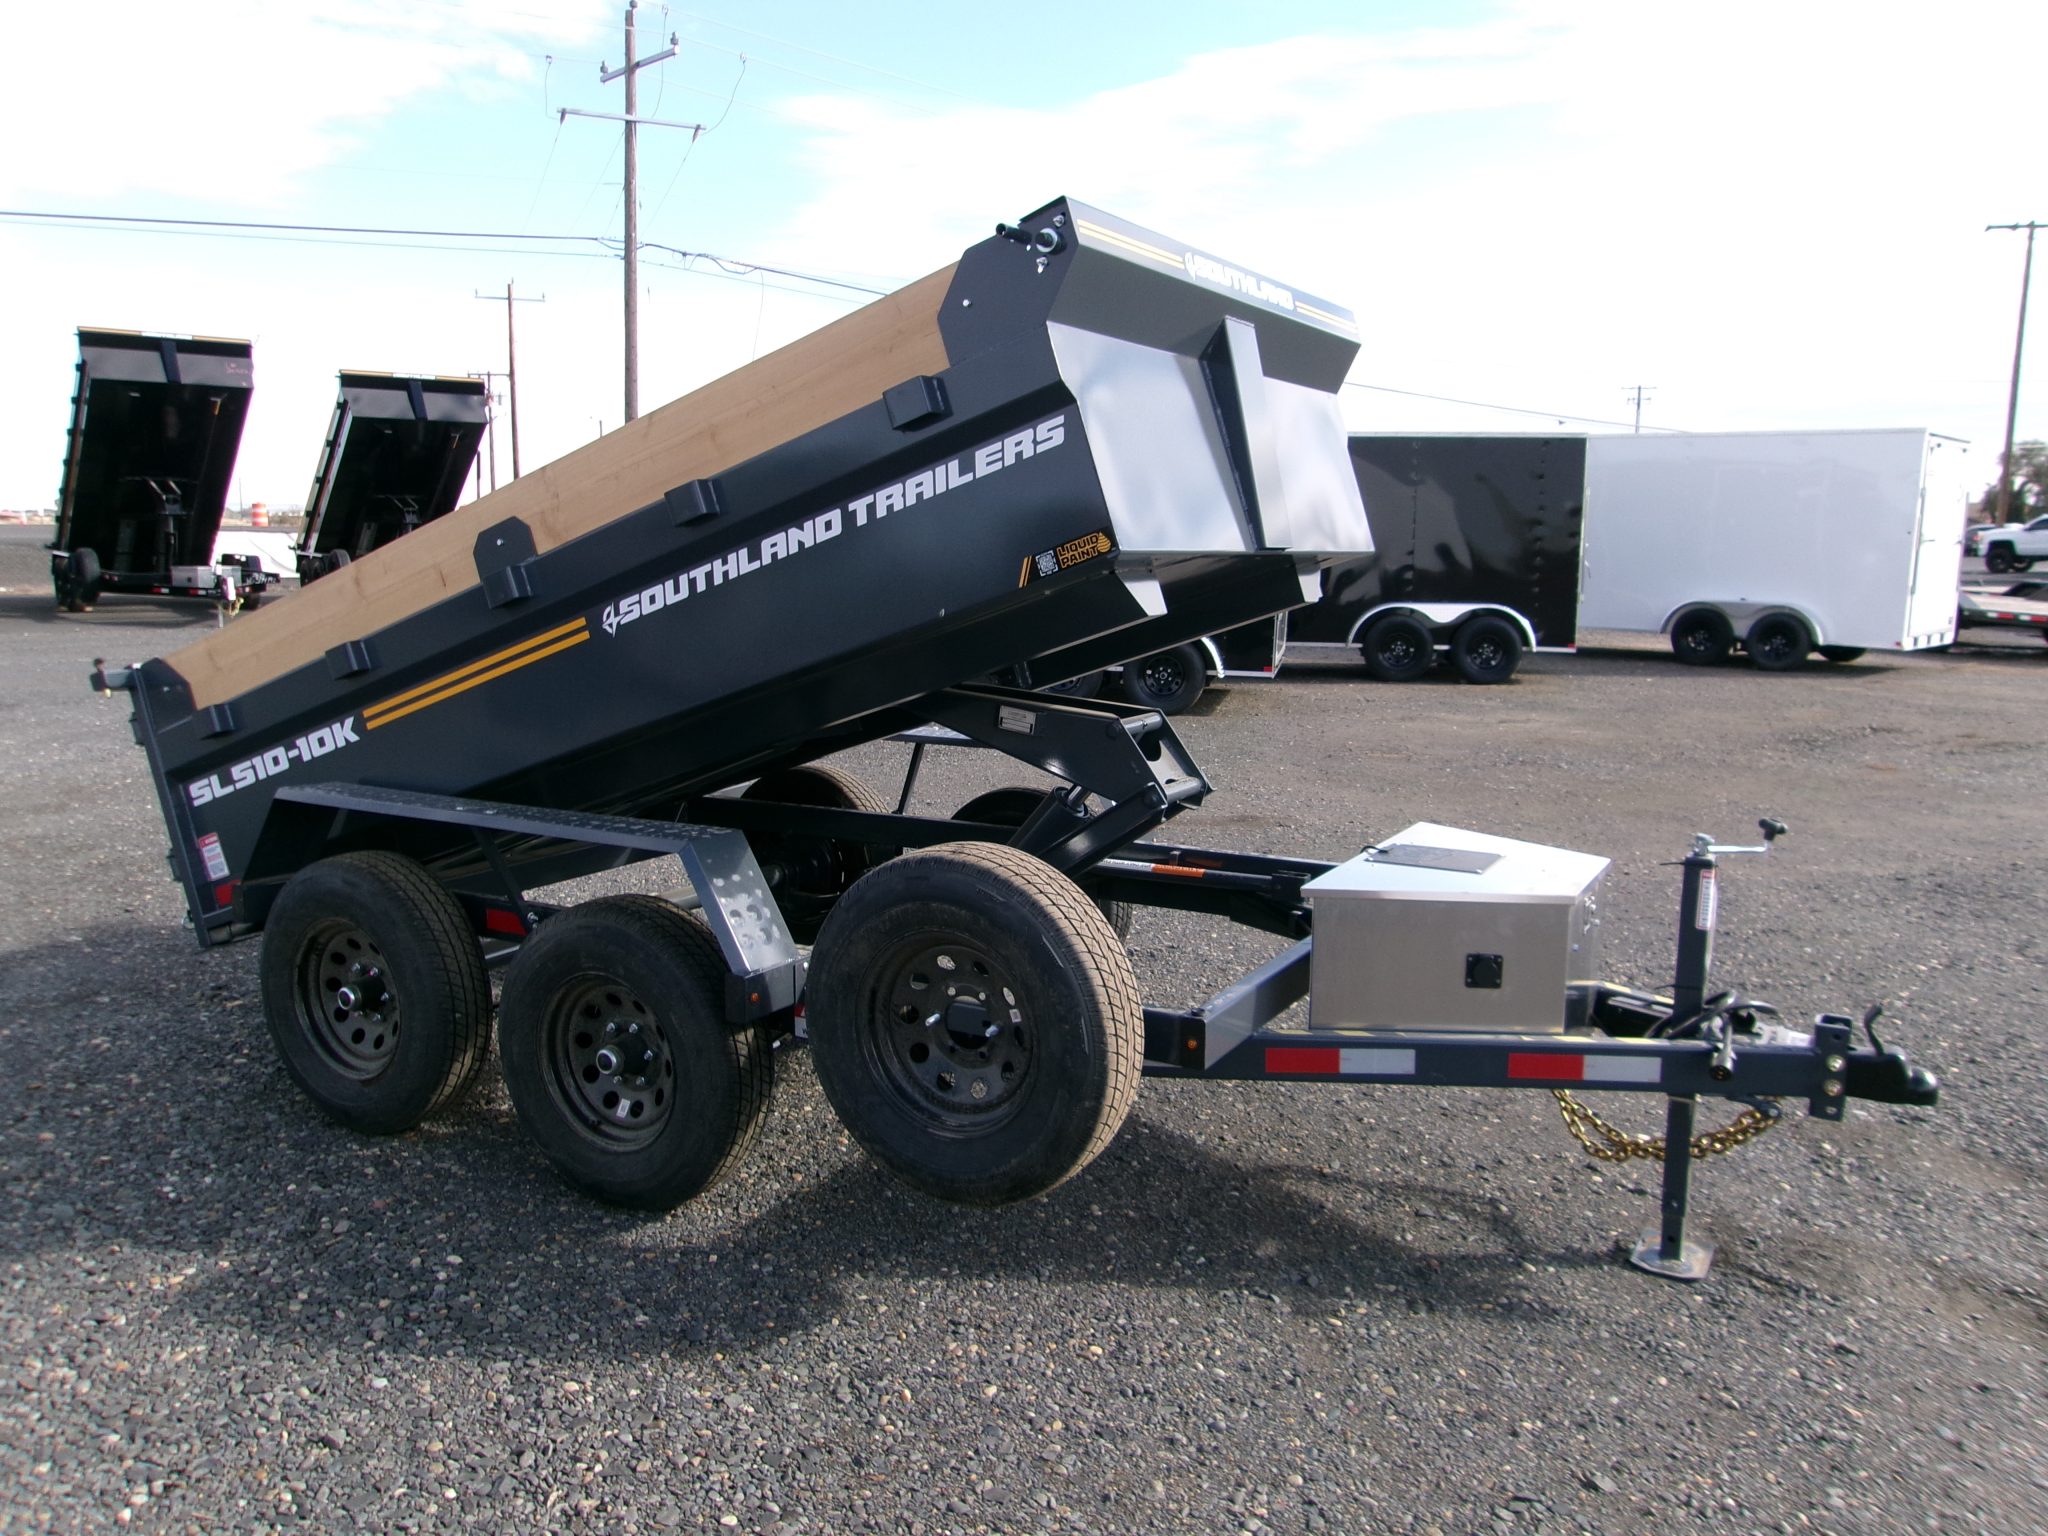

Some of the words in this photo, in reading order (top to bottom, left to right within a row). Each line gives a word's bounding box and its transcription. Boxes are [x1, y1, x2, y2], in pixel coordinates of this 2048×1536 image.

[619, 508, 842, 625] SOUTHLAND
[848, 415, 1065, 527] TRAILERS
[1056, 532, 1099, 557] LIQUID
[1059, 545, 1099, 569] PAINT
